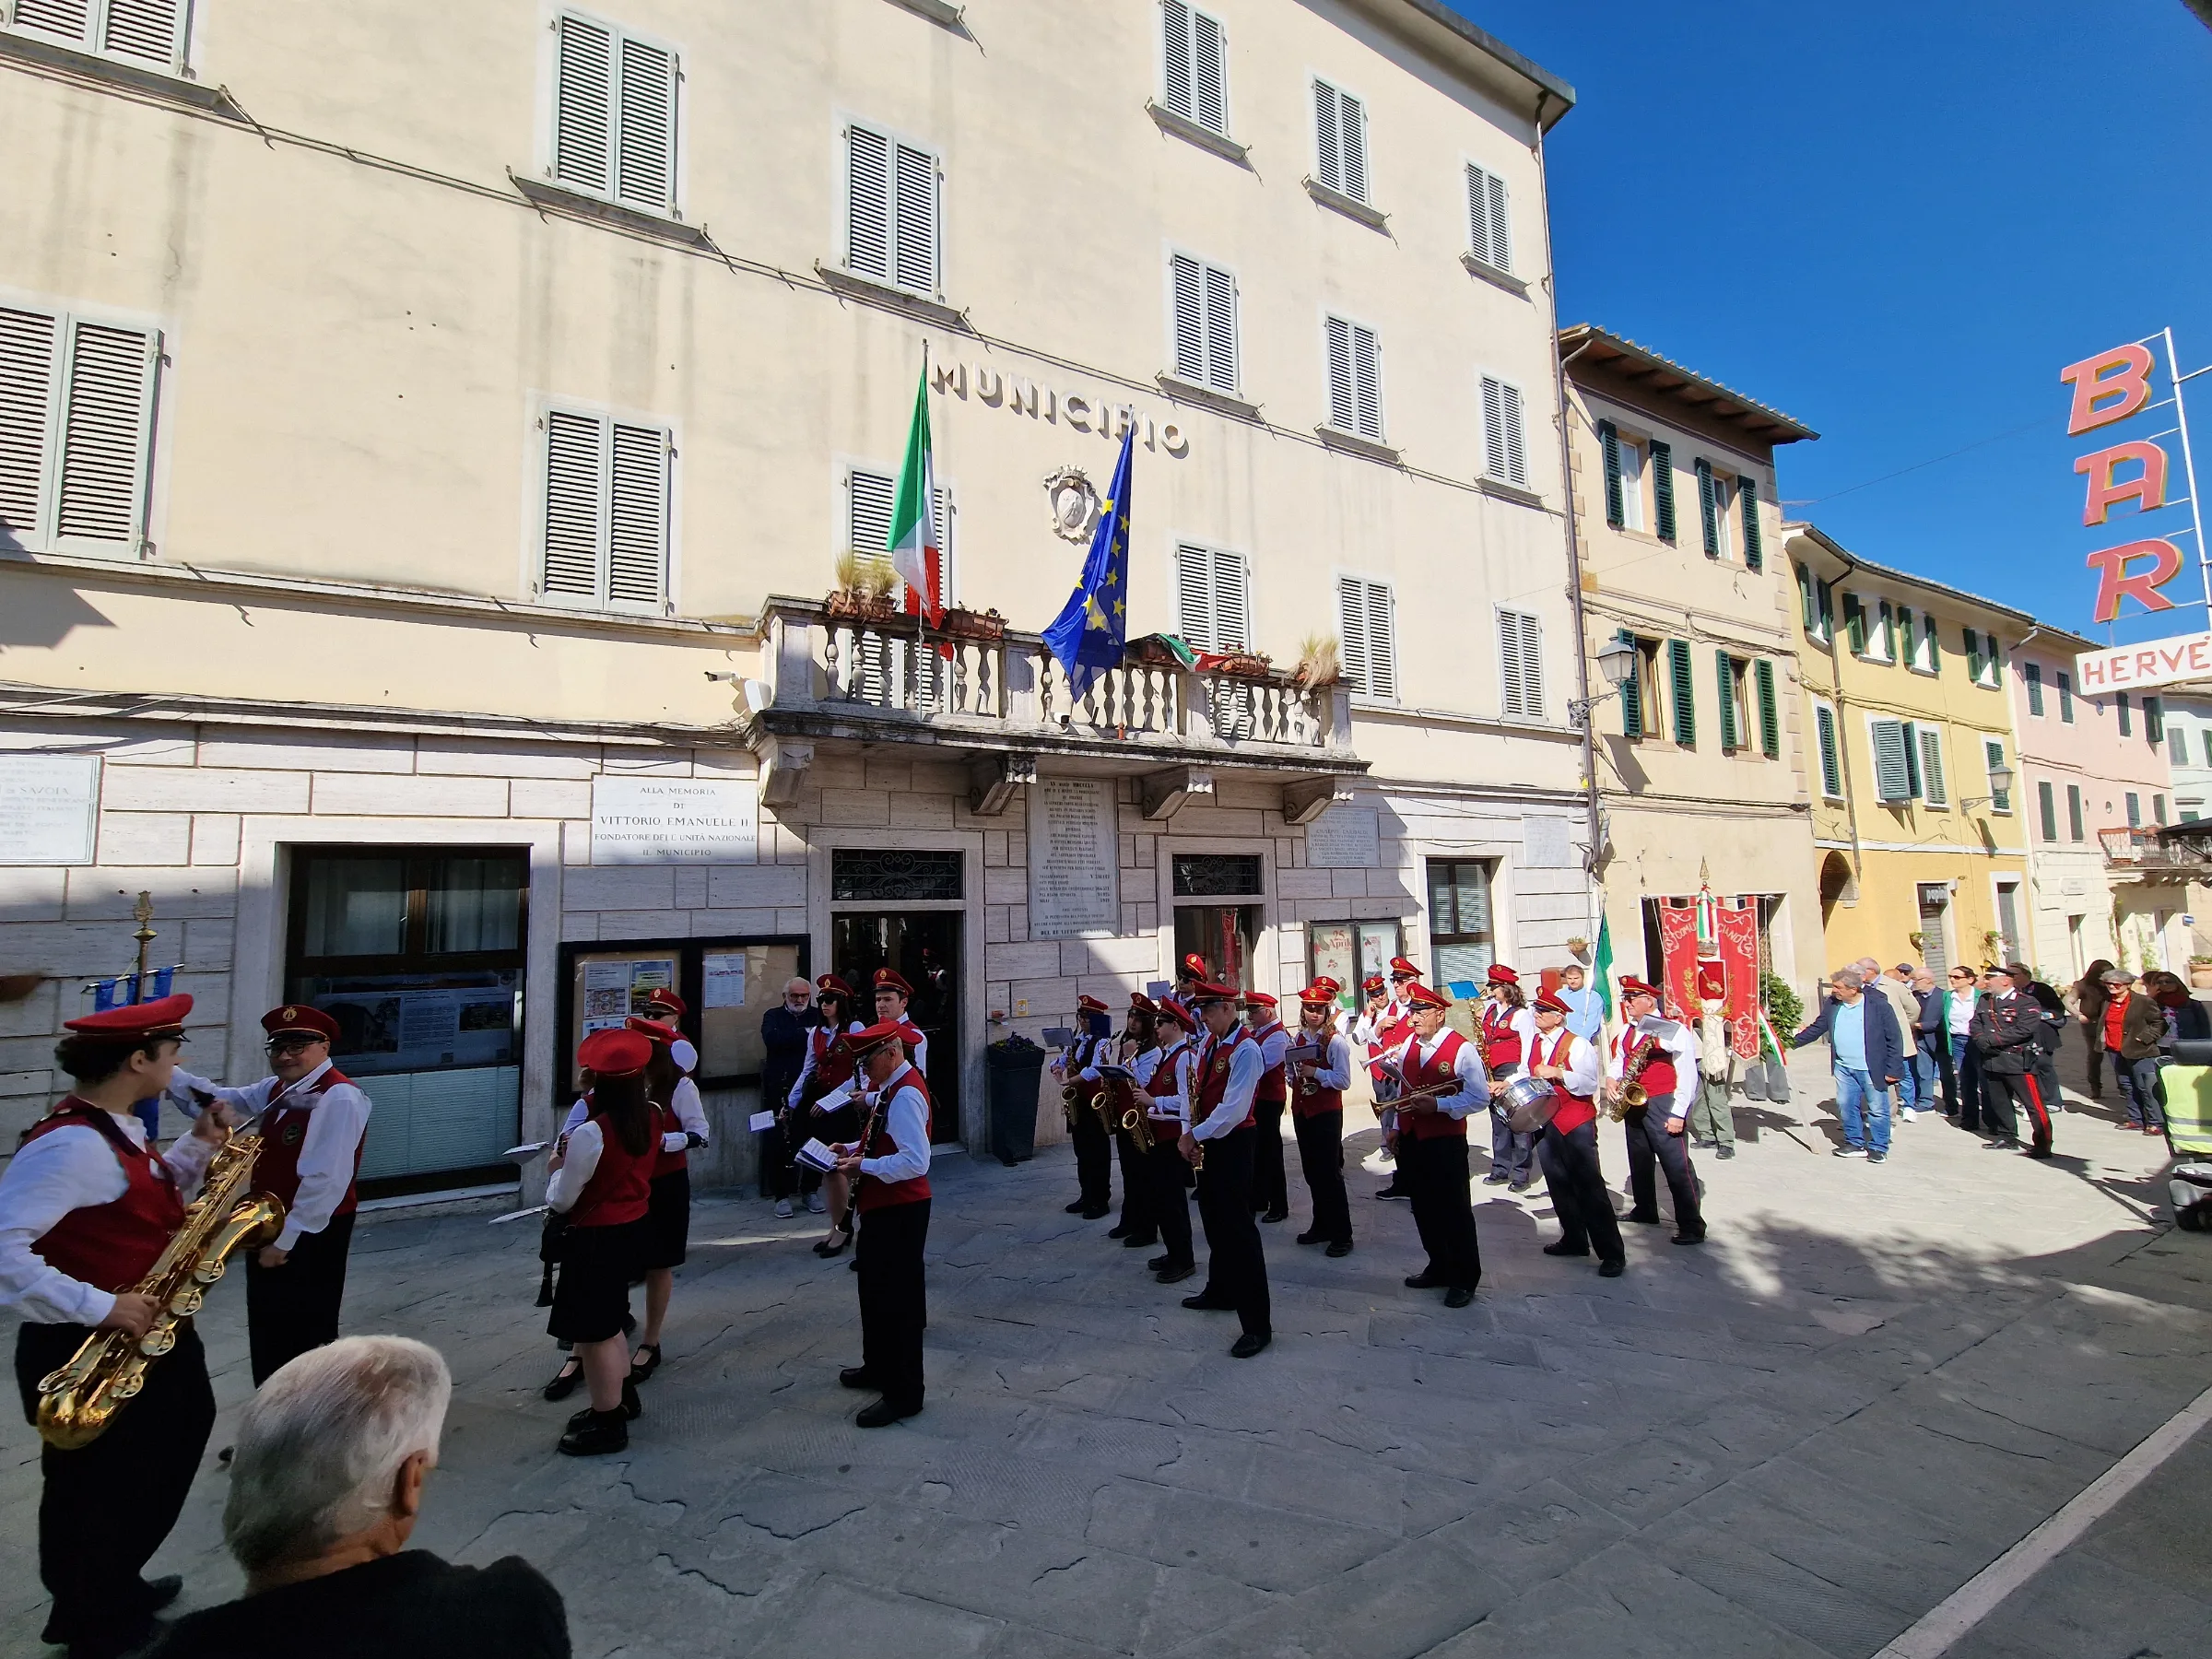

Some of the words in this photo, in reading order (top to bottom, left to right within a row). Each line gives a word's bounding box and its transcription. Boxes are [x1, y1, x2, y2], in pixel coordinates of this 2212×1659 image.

[928, 350, 1188, 455] MUNICIPIO
[2061, 344, 2183, 623] BAR
[600, 817, 661, 826] VITTORIO
[667, 817, 735, 827] EMANUELE
[1333, 930, 1345, 940] 25
[1675, 922, 1697, 939] COMU
[1717, 923, 1742, 943] CIANO
